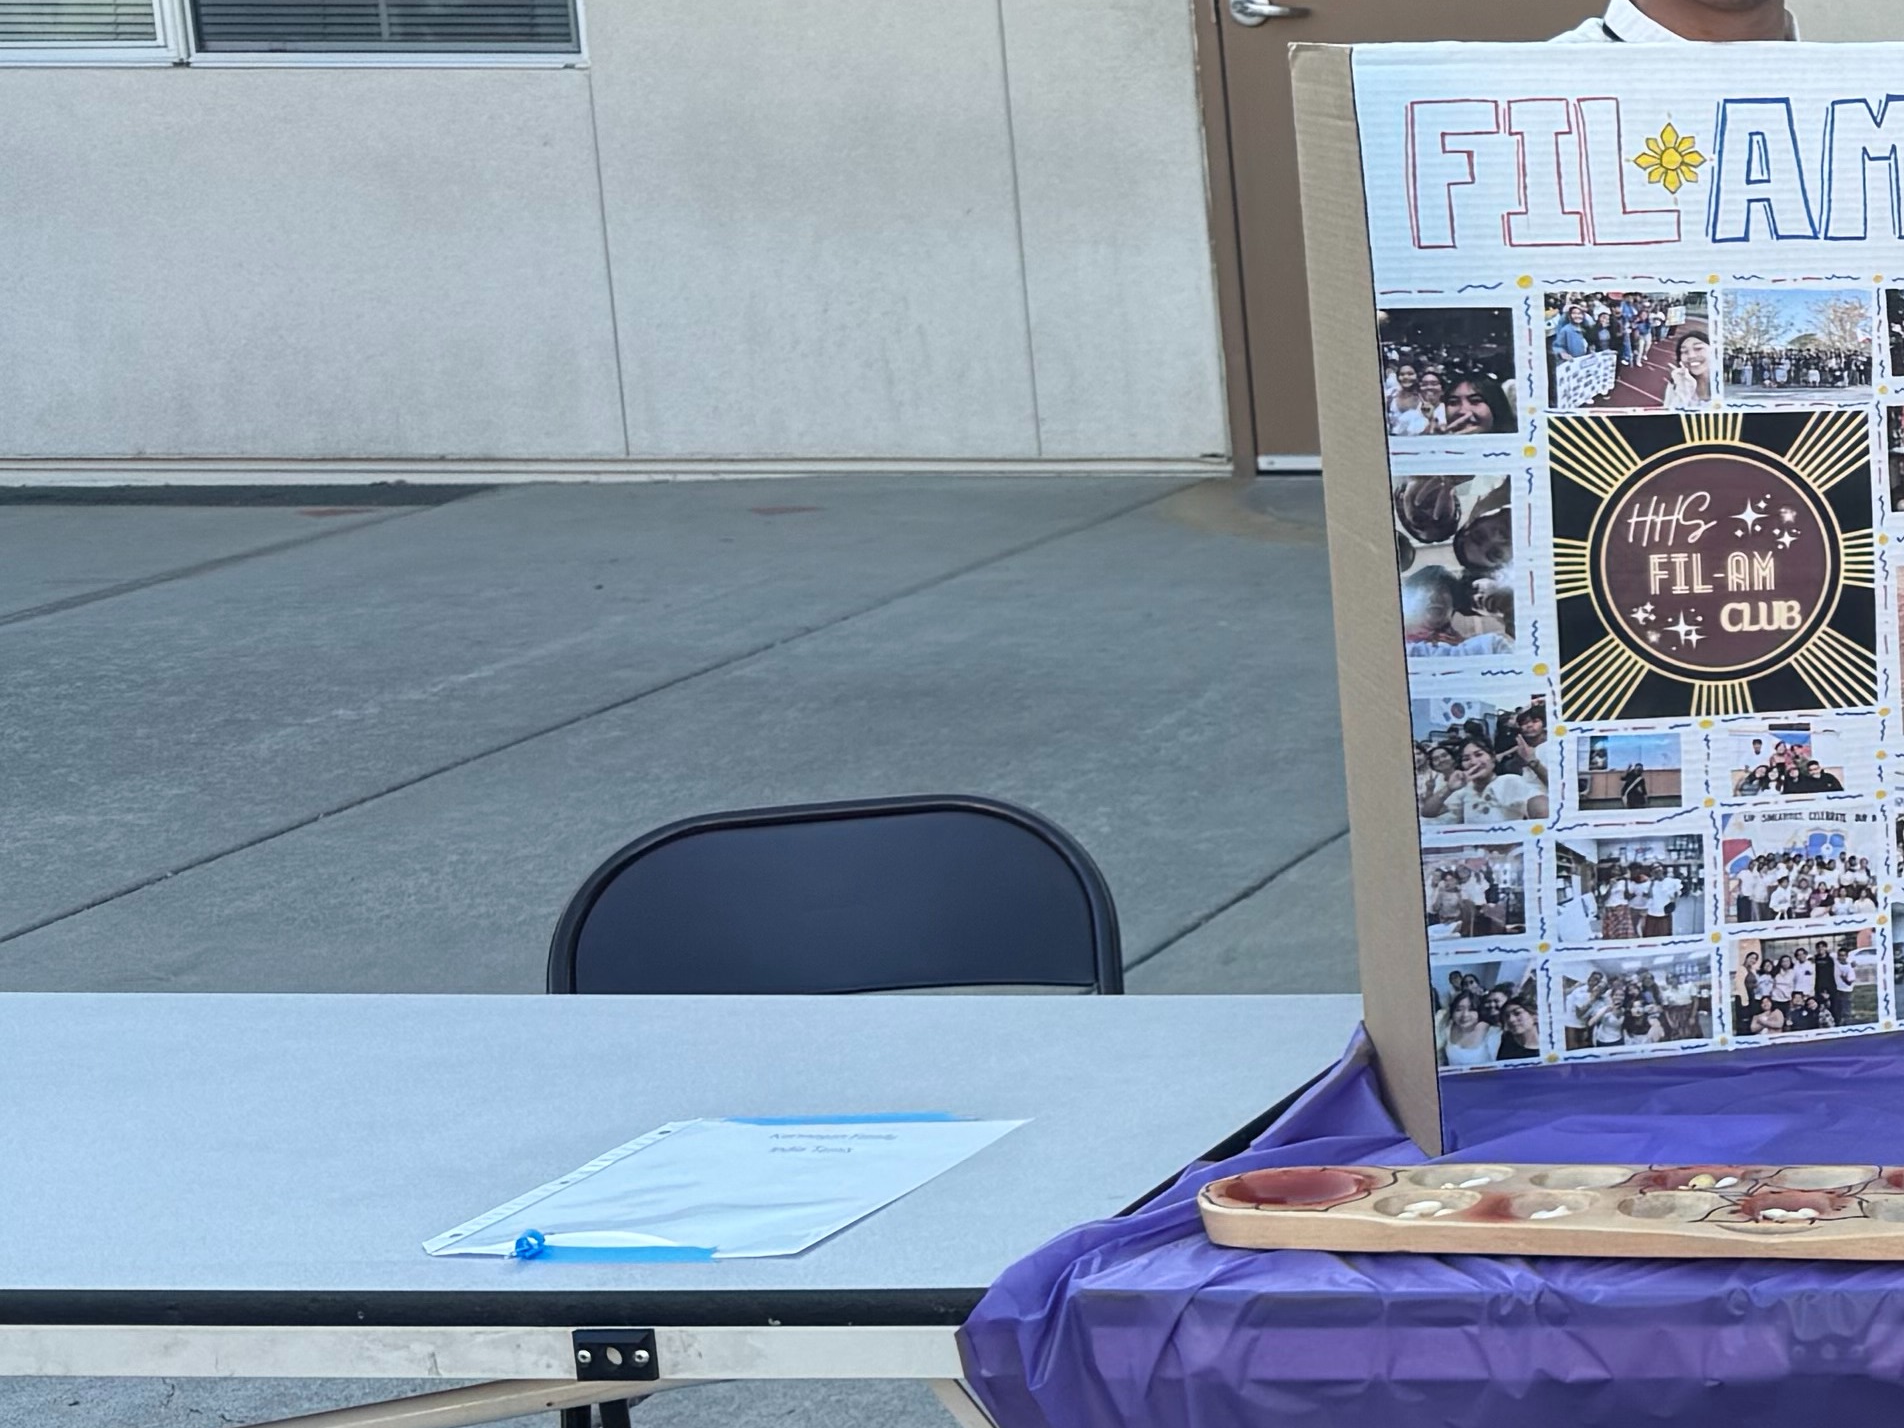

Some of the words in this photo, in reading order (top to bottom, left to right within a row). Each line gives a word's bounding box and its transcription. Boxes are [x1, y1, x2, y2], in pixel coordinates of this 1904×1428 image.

[1405, 97, 1680, 248] FIL
[1627, 491, 1717, 547] HHS
[1649, 551, 1775, 595] FIL-AM
[1720, 600, 1802, 632] CLUB
